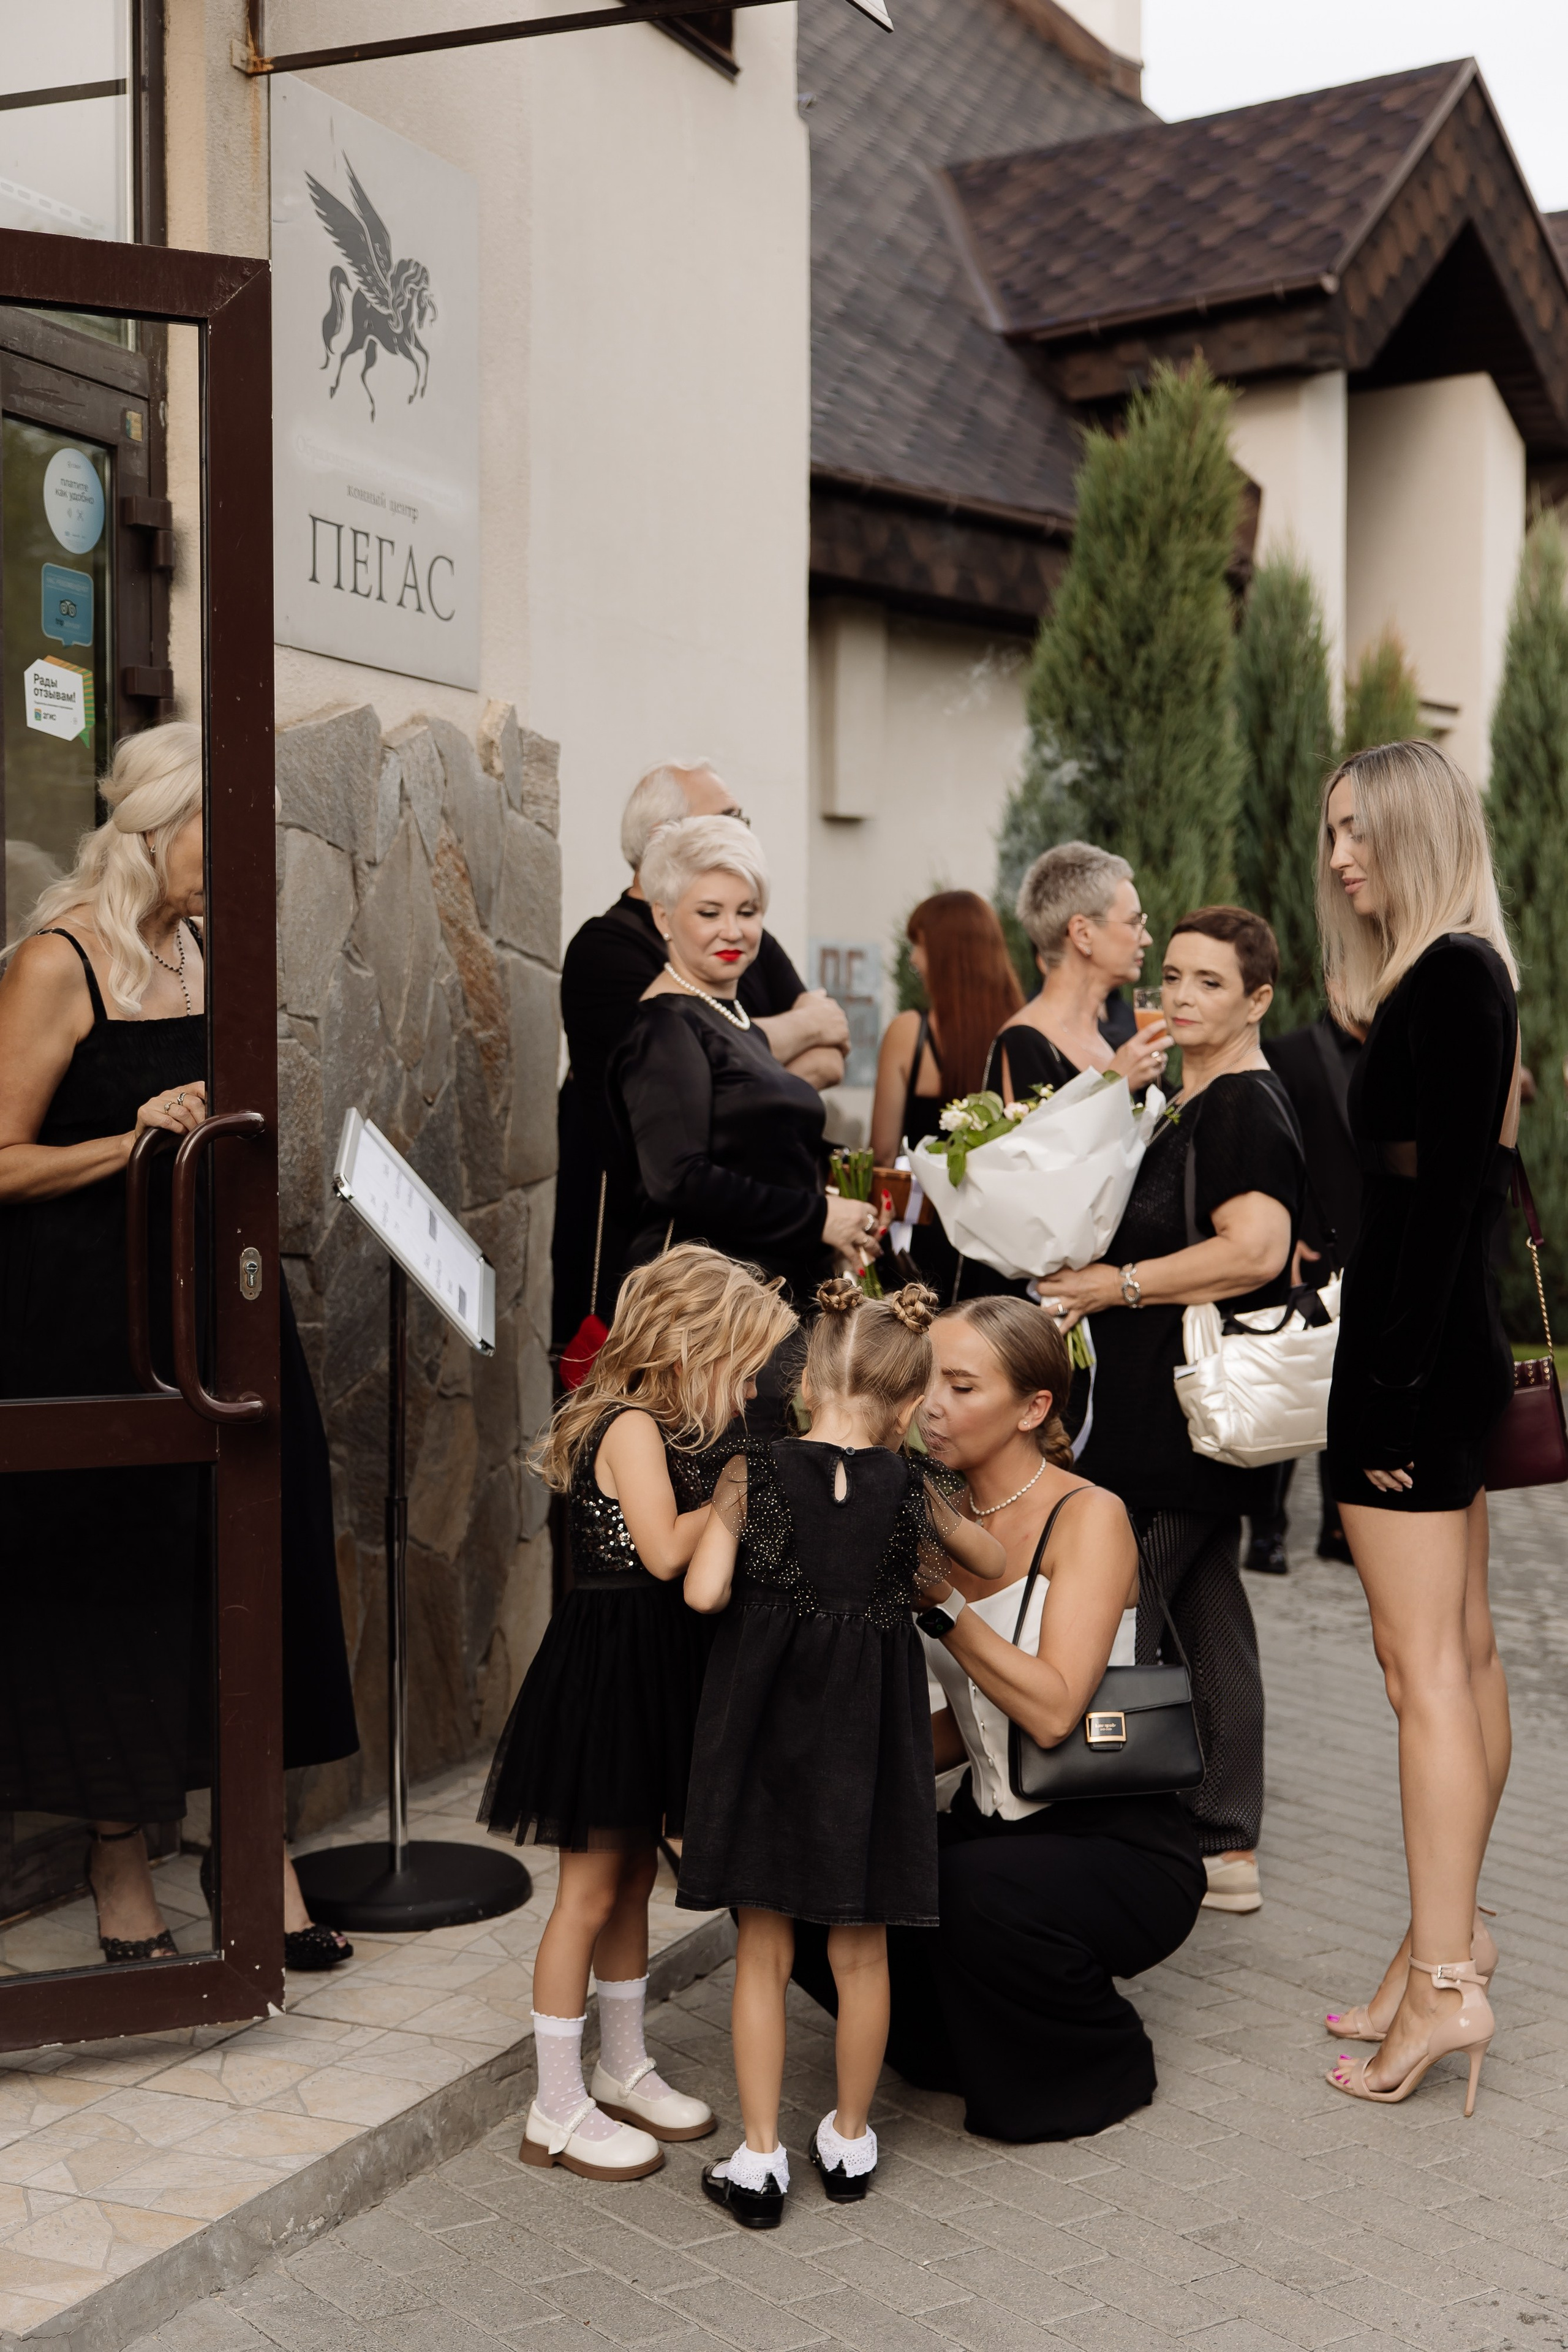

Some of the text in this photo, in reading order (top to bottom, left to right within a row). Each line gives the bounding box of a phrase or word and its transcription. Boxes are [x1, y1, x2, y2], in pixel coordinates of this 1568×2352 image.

[347, 484, 419, 524] конный центр
[307, 513, 456, 622] ПЕГАС
[34, 673, 58, 688] Рады
[34, 688, 76, 703] отзывам!
